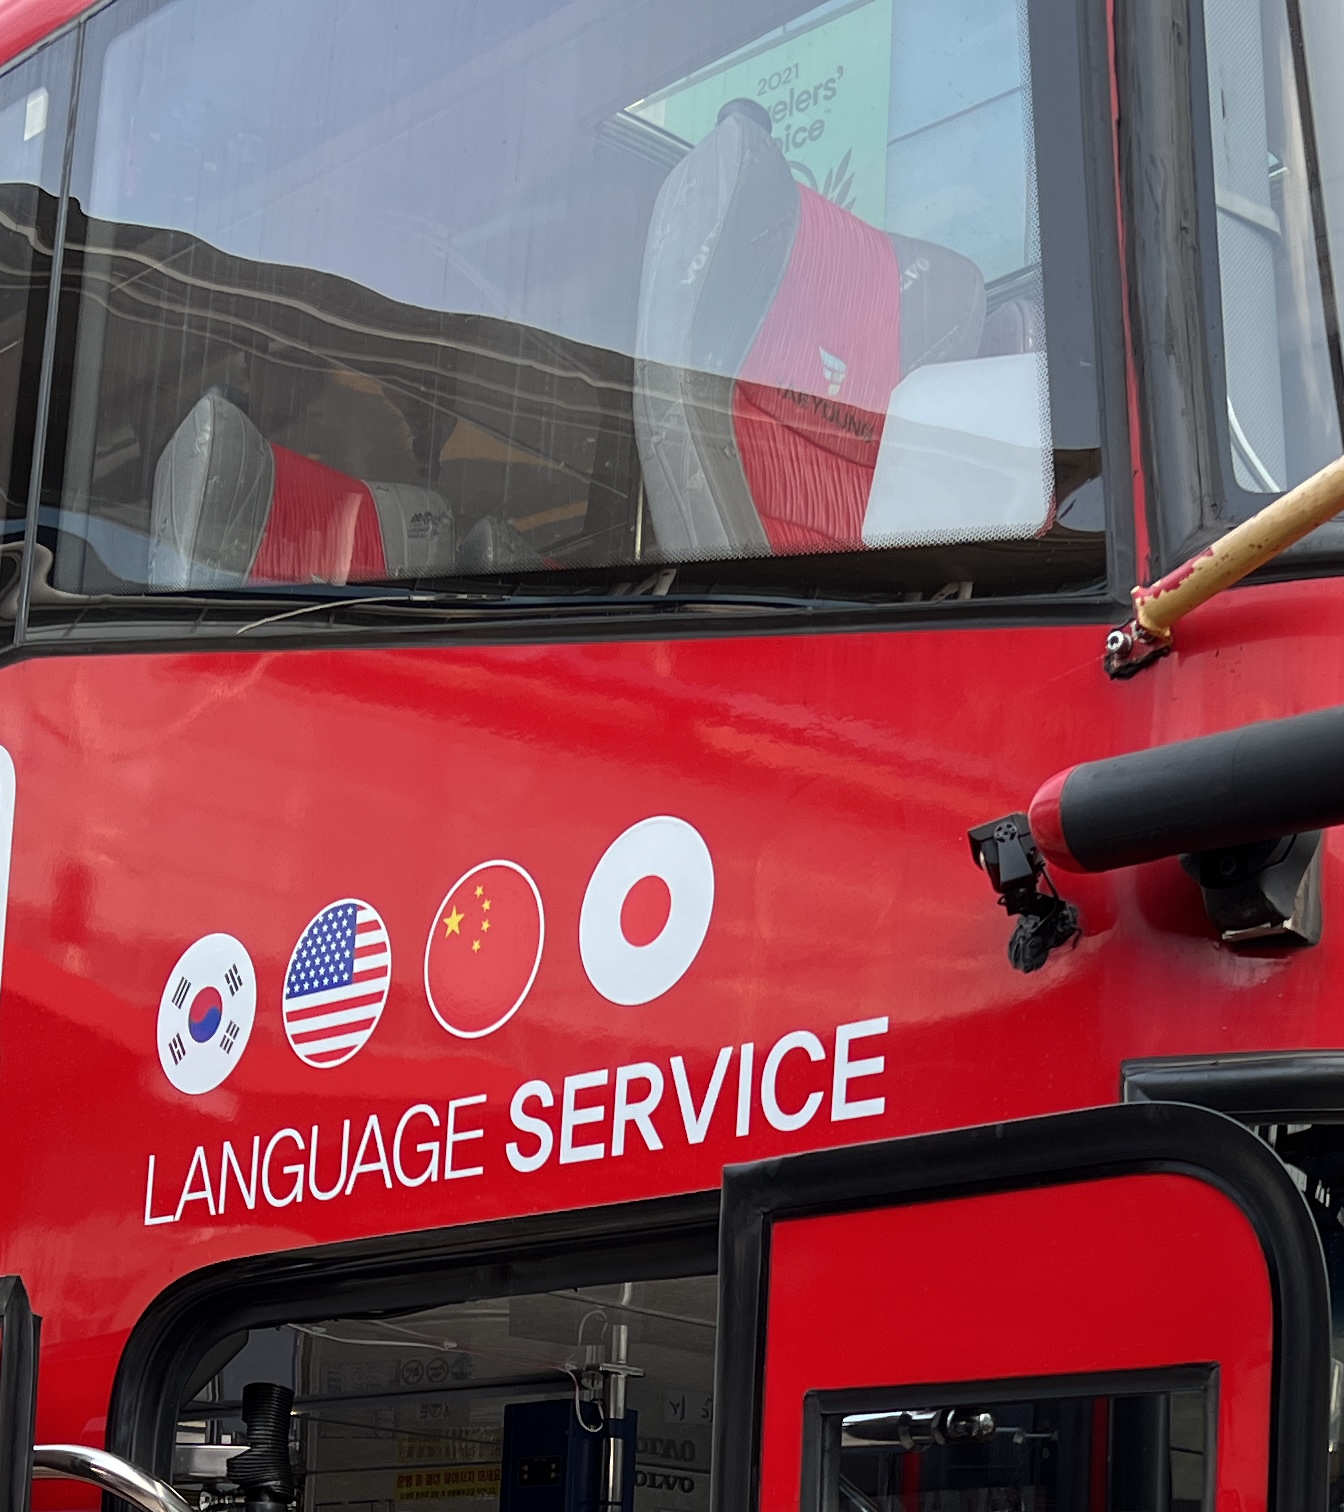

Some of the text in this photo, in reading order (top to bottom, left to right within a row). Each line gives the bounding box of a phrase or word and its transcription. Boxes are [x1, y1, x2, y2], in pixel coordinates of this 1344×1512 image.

[757, 63, 799, 97] 2021
[144, 1015, 890, 1226] LANGUAGE SERVICE
